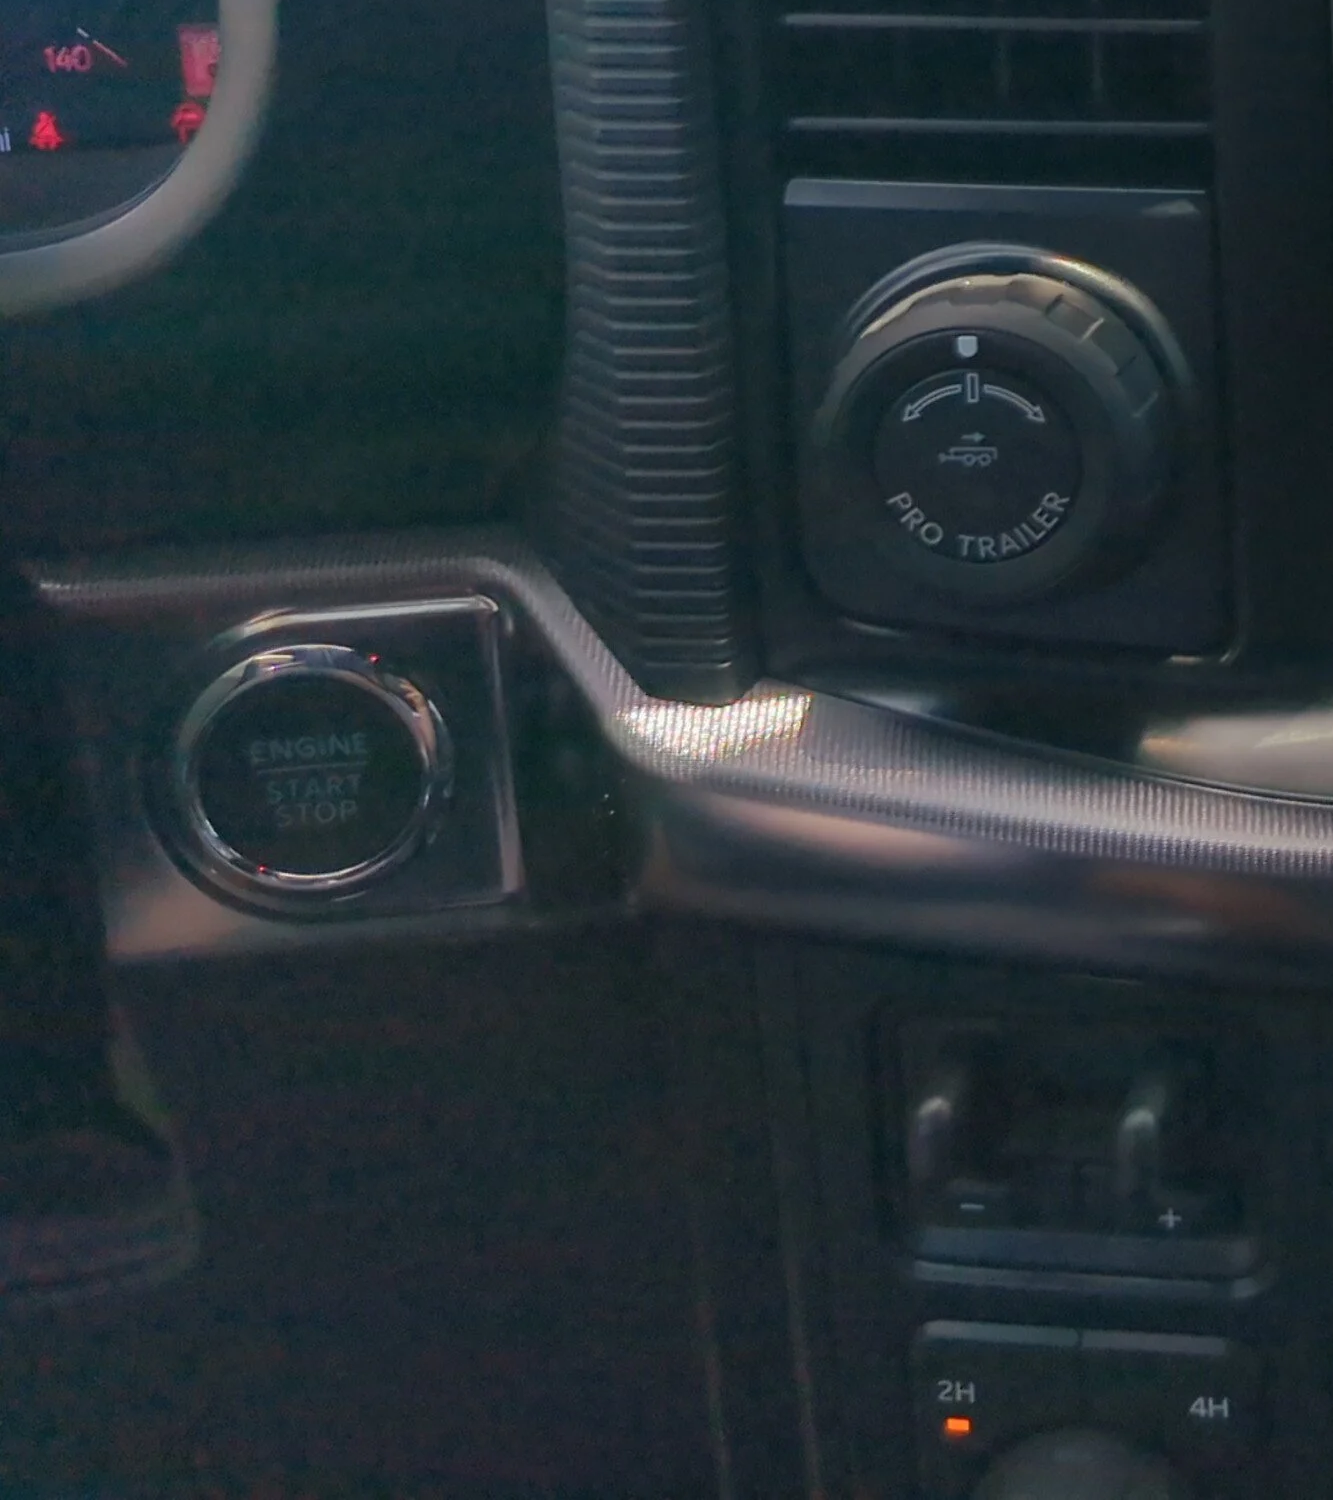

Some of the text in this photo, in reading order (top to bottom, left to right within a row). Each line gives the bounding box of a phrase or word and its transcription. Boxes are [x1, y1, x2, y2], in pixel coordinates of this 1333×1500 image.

[44, 44, 94, 73] 140
[887, 491, 1070, 558] PRO TRAILER
[250, 731, 368, 762] ENGINE
[266, 773, 362, 803] START
[279, 801, 358, 829] STOP
[936, 1380, 976, 1405] 2H
[1189, 1396, 1230, 1419] 4H
